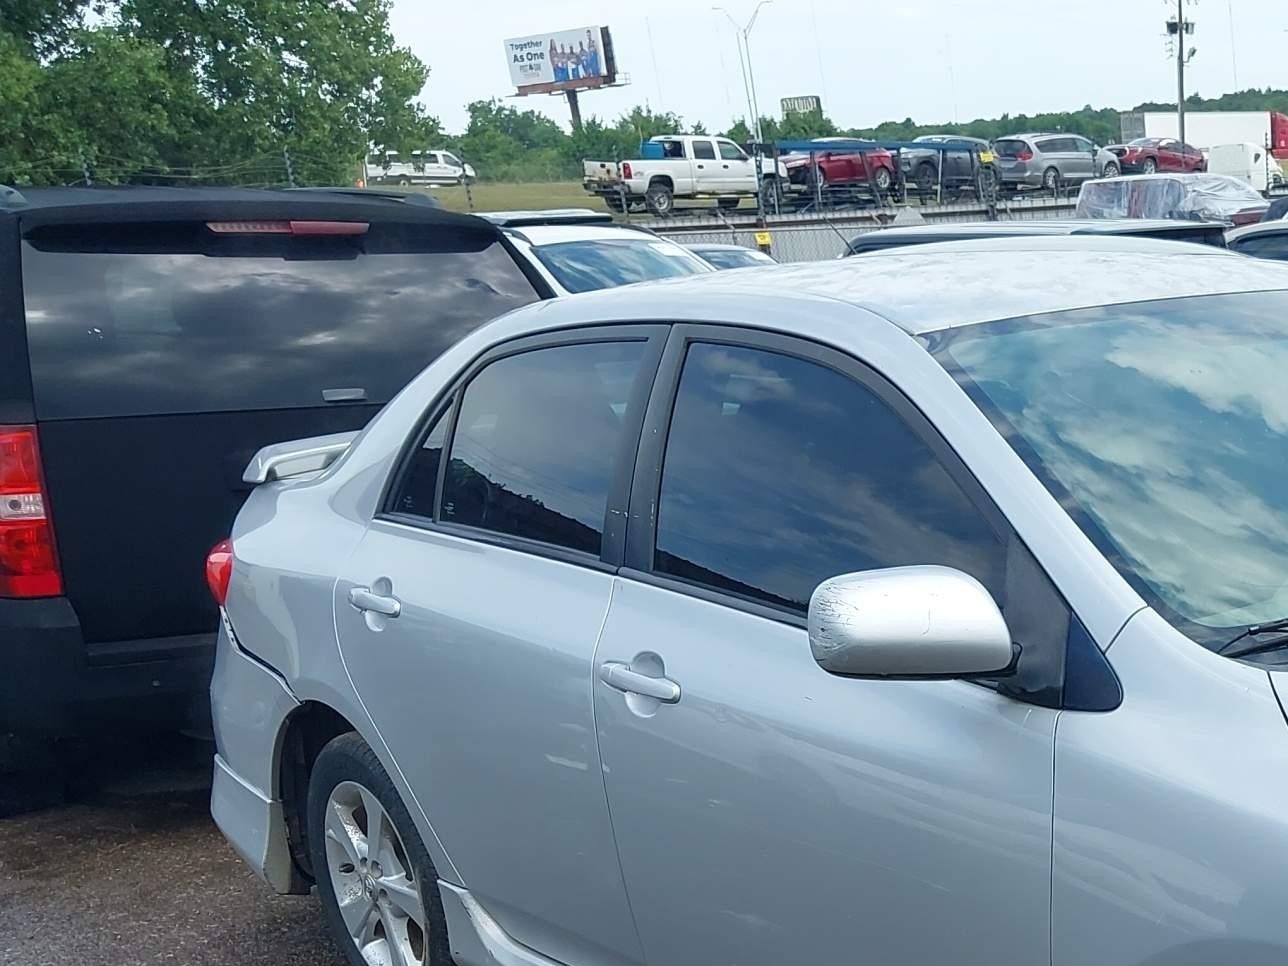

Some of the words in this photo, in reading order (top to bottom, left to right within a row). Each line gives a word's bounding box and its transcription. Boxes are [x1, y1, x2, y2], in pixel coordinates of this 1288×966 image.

[510, 40, 542, 51] Together
[513, 53, 525, 63] As
[526, 52, 545, 61] One
